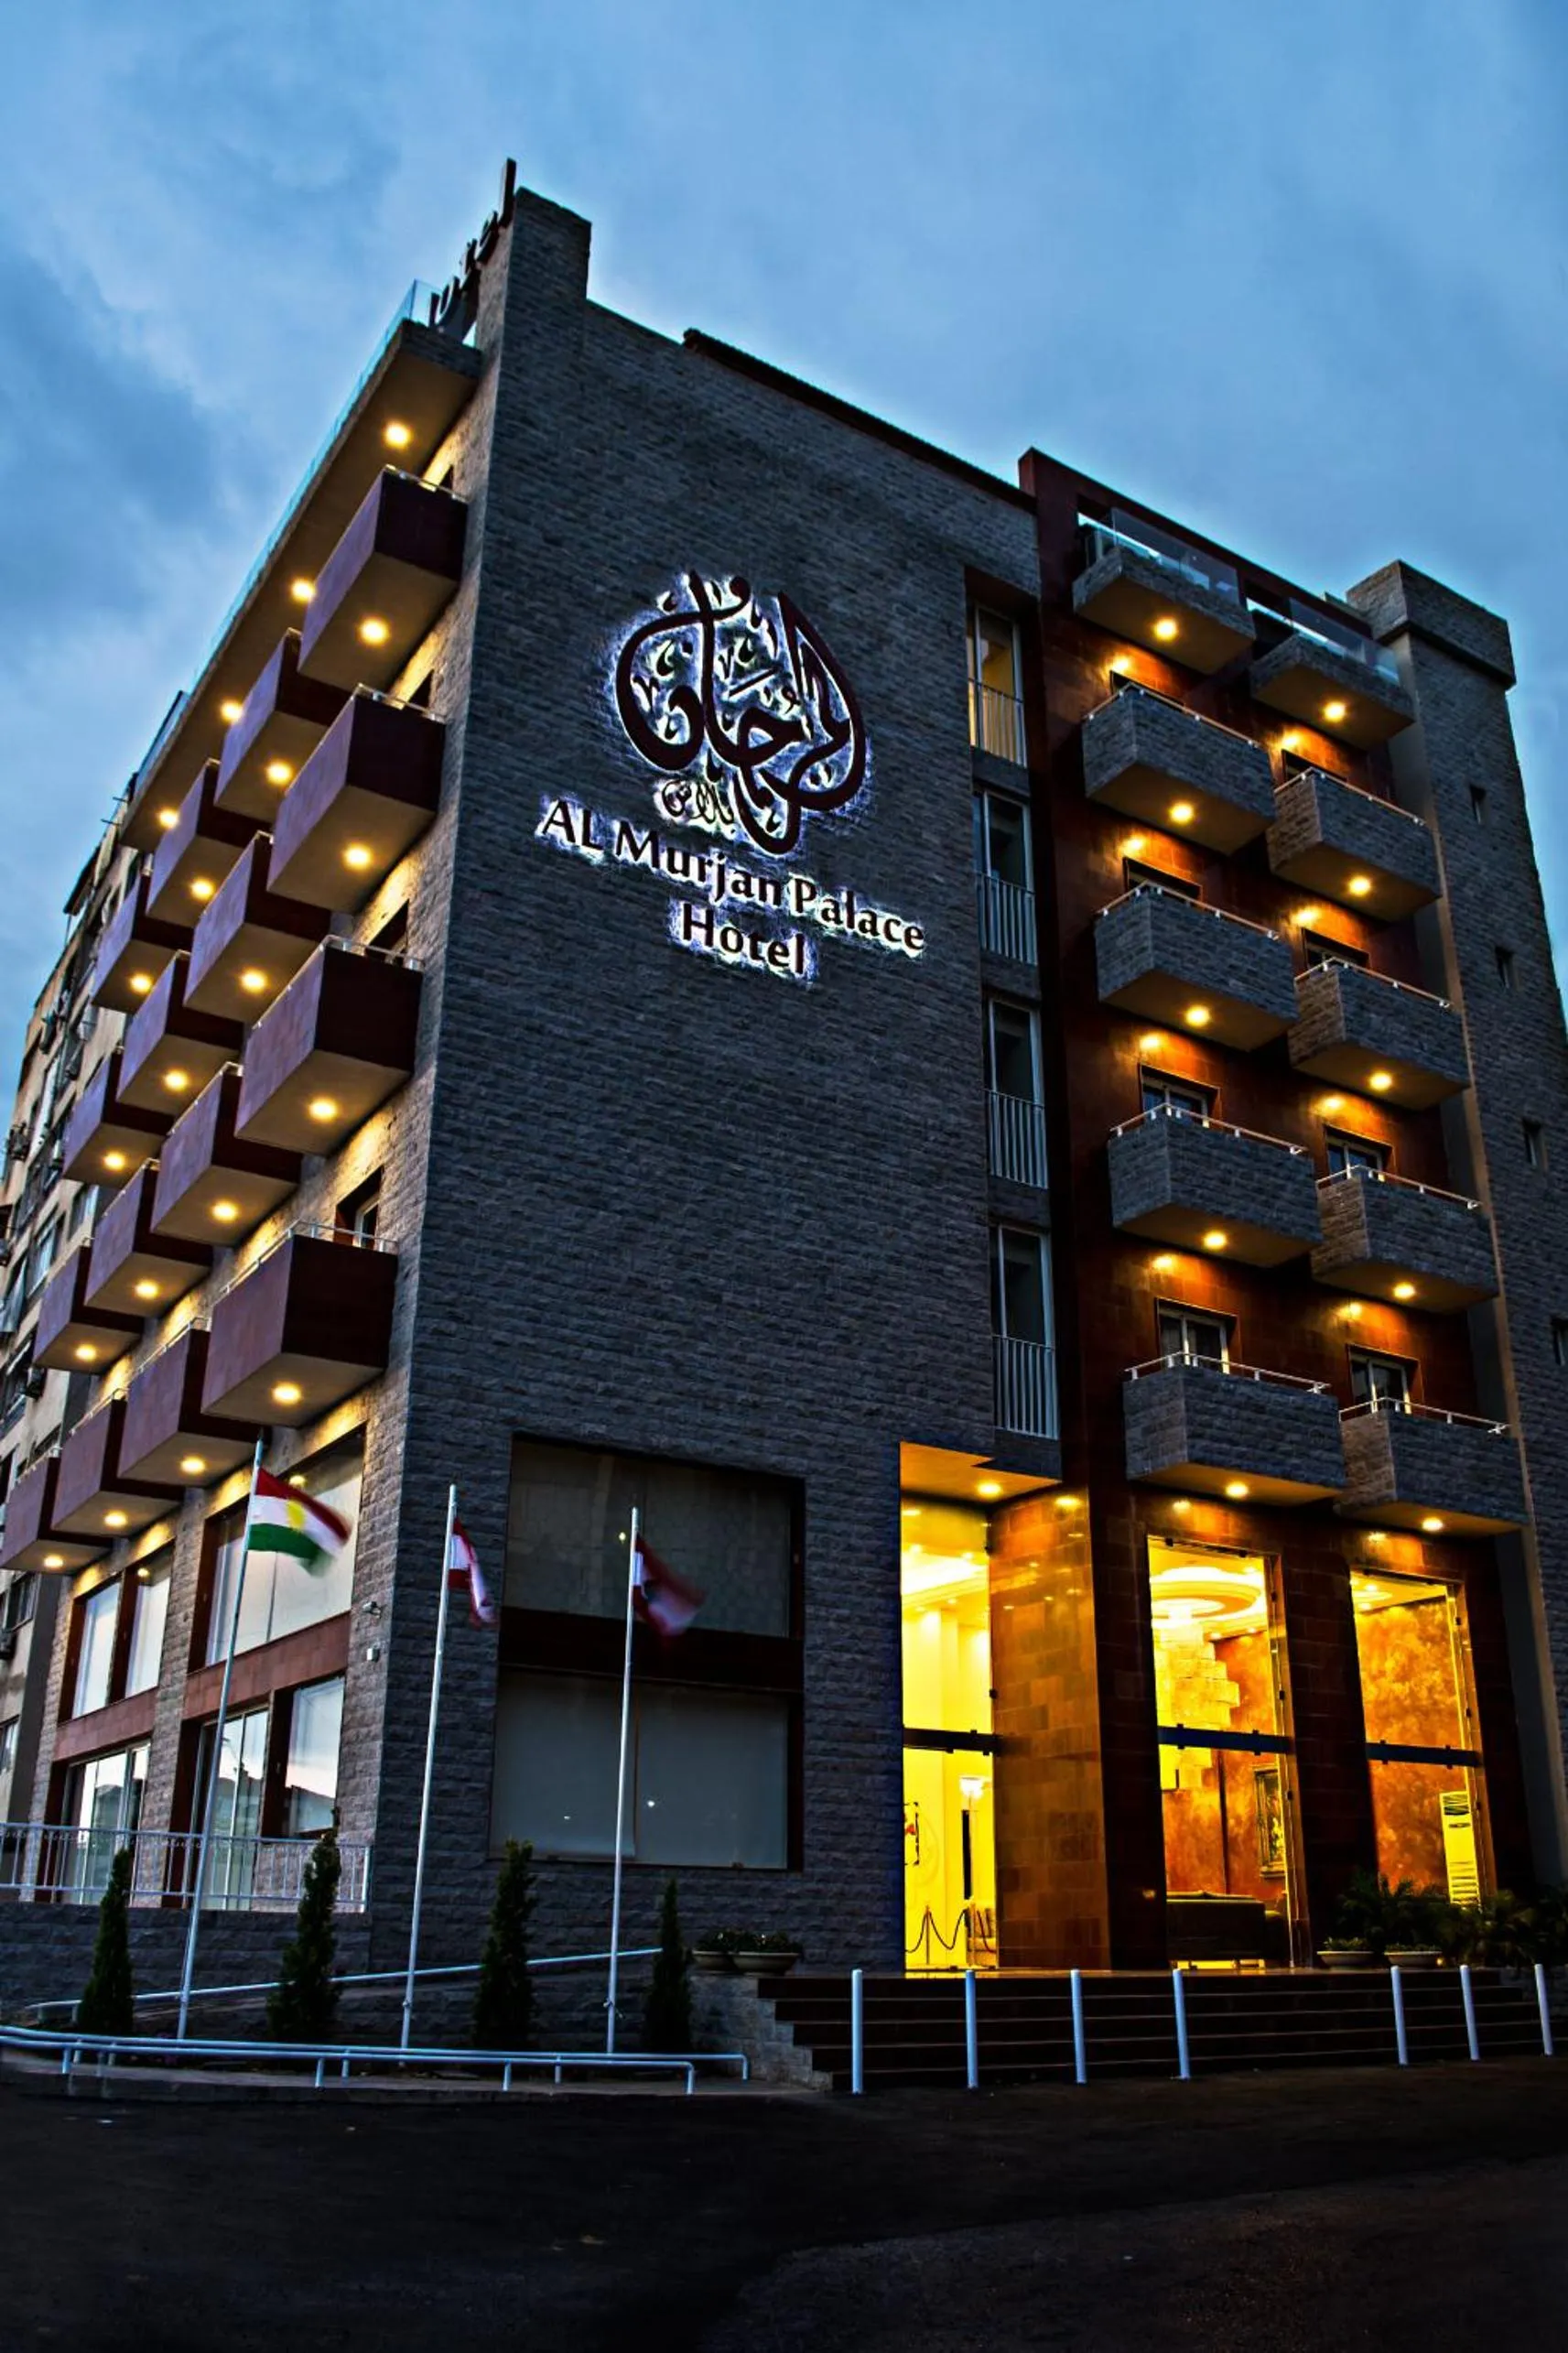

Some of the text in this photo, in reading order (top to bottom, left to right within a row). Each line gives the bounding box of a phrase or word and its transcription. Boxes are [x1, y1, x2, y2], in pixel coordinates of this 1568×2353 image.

[541, 798, 926, 951] AL Murjan Palace
[680, 902, 806, 974] Hotel
